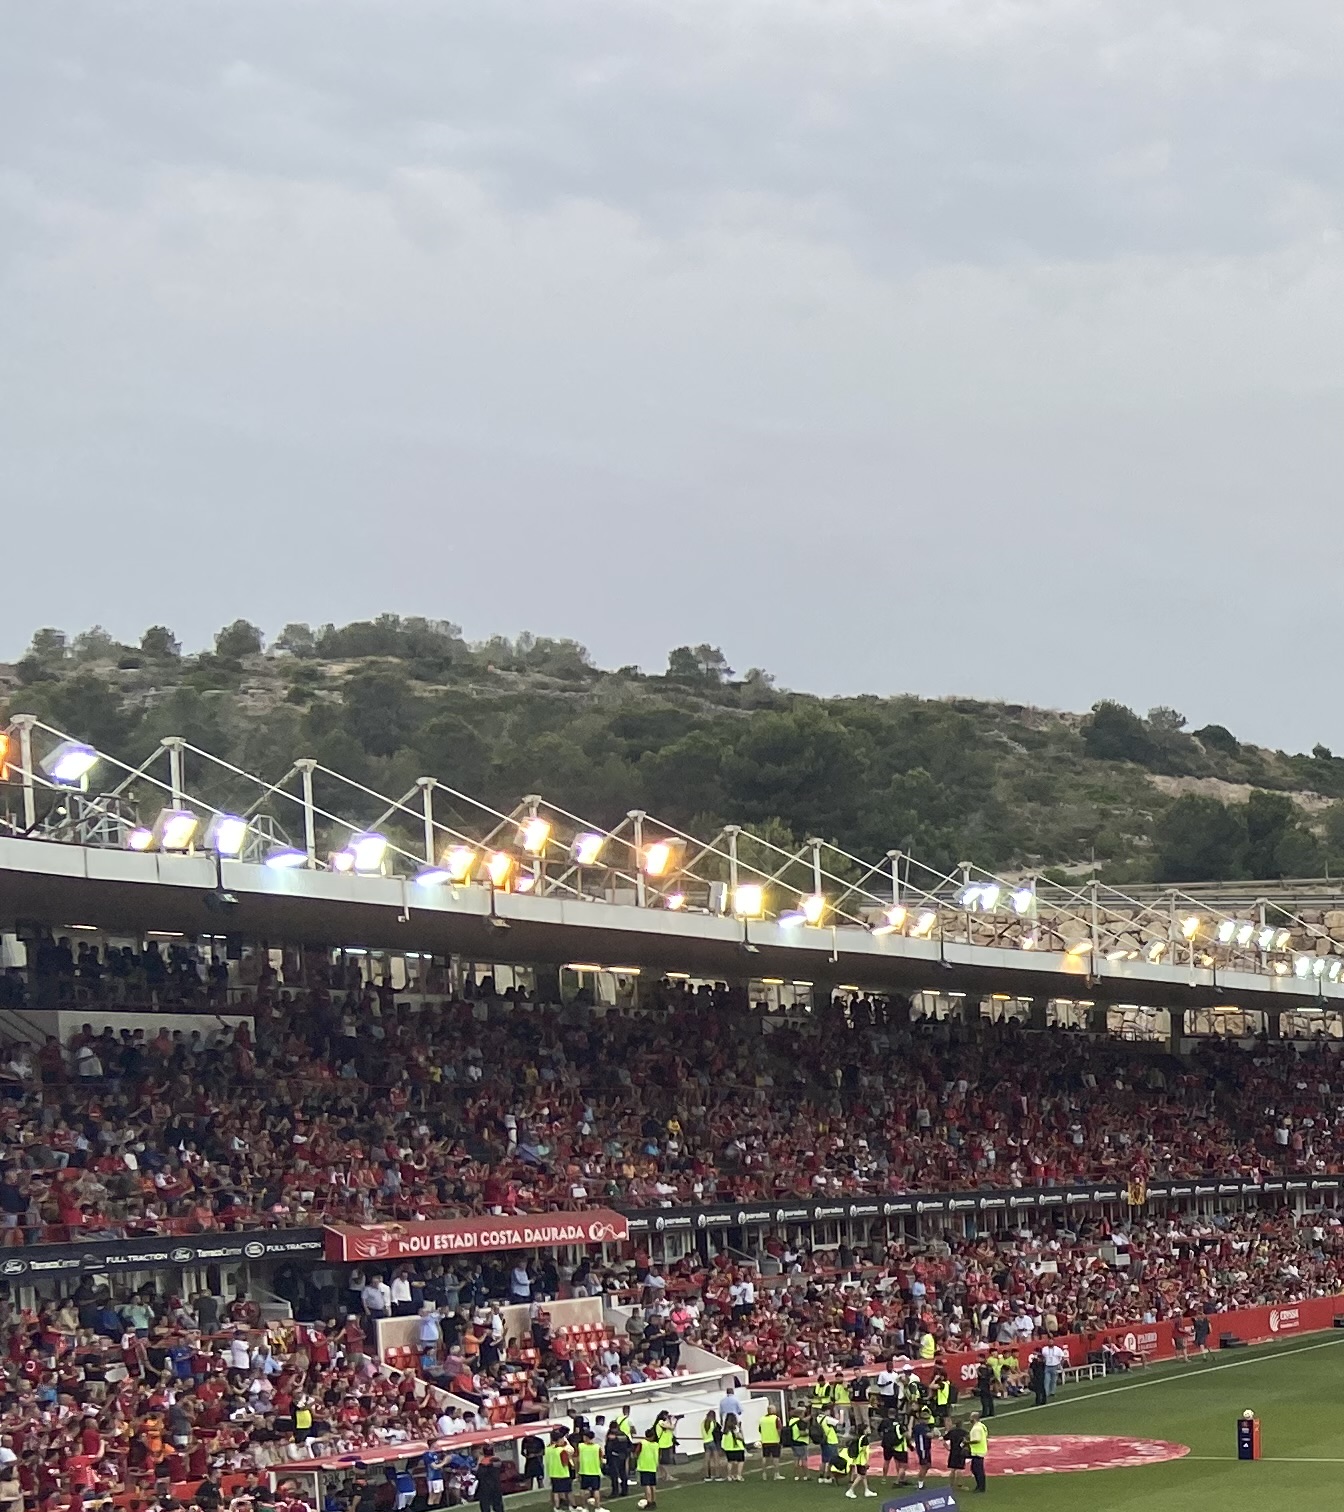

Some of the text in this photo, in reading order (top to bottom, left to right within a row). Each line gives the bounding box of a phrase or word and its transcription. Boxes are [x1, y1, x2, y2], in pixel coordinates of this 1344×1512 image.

[399, 1225, 585, 1252] NOU ESTADI COSTA DAURADA
[266, 1243, 285, 1253] FULL
[286, 1242, 322, 1251] TRACTION
[106, 1255, 127, 1264] FULL
[128, 1253, 168, 1263] TRACTION
